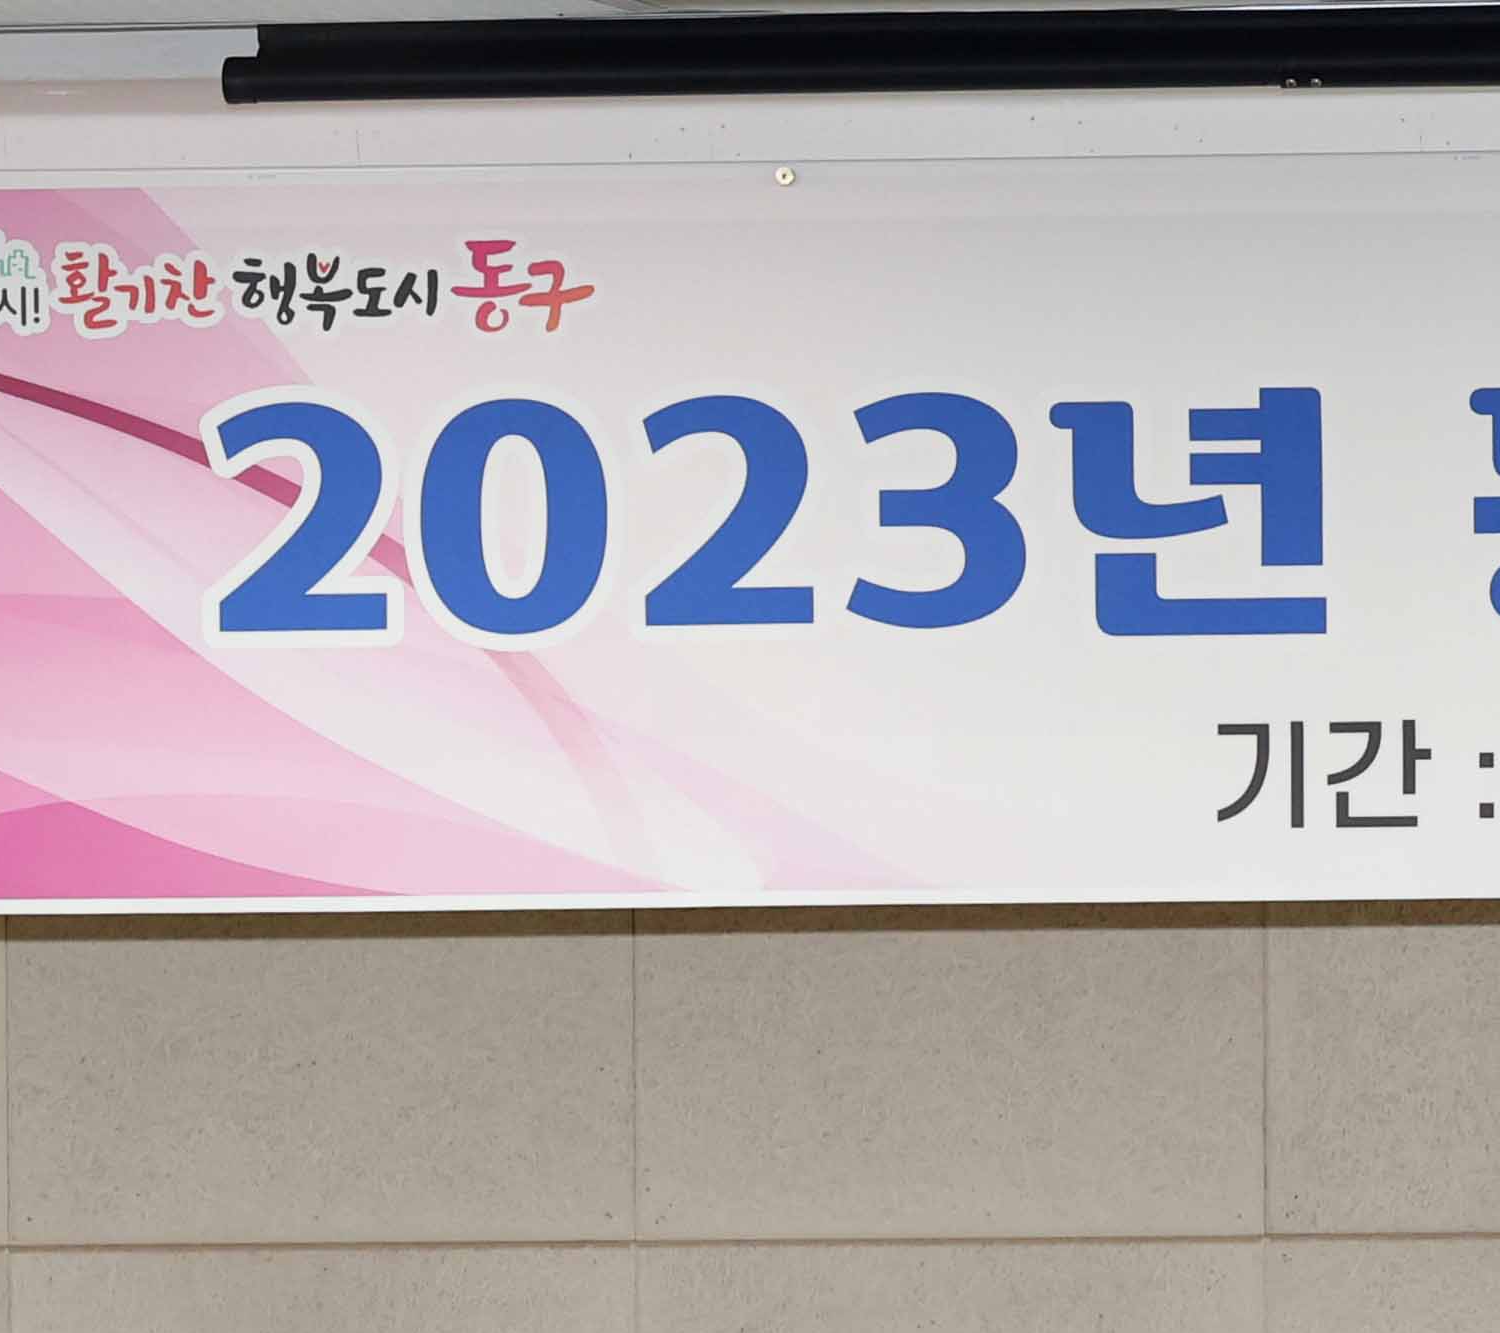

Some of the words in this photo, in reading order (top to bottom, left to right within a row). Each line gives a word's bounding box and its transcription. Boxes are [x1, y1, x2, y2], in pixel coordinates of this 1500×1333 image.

[57, 251, 216, 330] 활기찬
[232, 252, 439, 332] 행복도시
[450, 239, 596, 333] 동구
[217, 386, 1328, 637] 2023년
[1216, 718, 1432, 829] 기간
